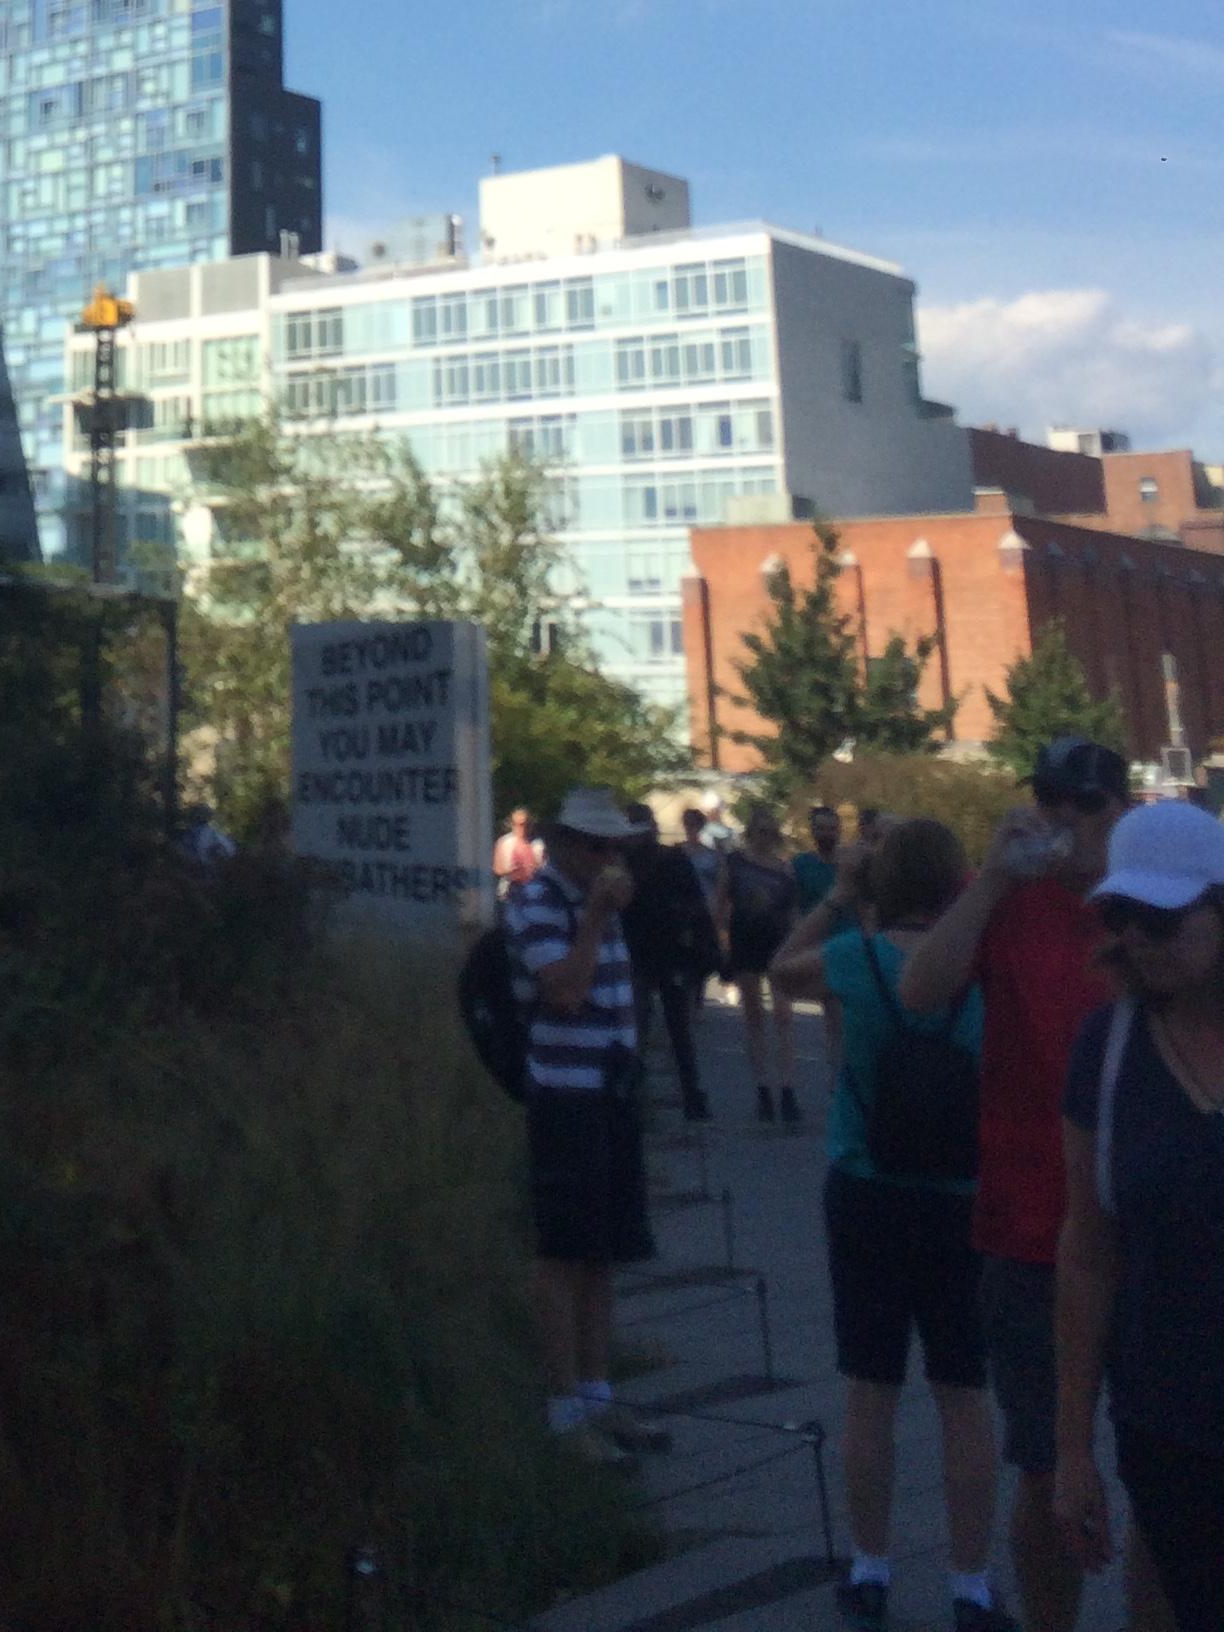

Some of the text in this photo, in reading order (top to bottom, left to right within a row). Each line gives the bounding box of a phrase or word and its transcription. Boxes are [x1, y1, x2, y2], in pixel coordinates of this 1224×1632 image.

[321, 628, 433, 676] BEYOND
[306, 668, 451, 718] THIS POINT
[319, 720, 438, 762] YOU MAY
[297, 767, 460, 805] ENCOUNTER
[337, 815, 411, 852] NUDE
